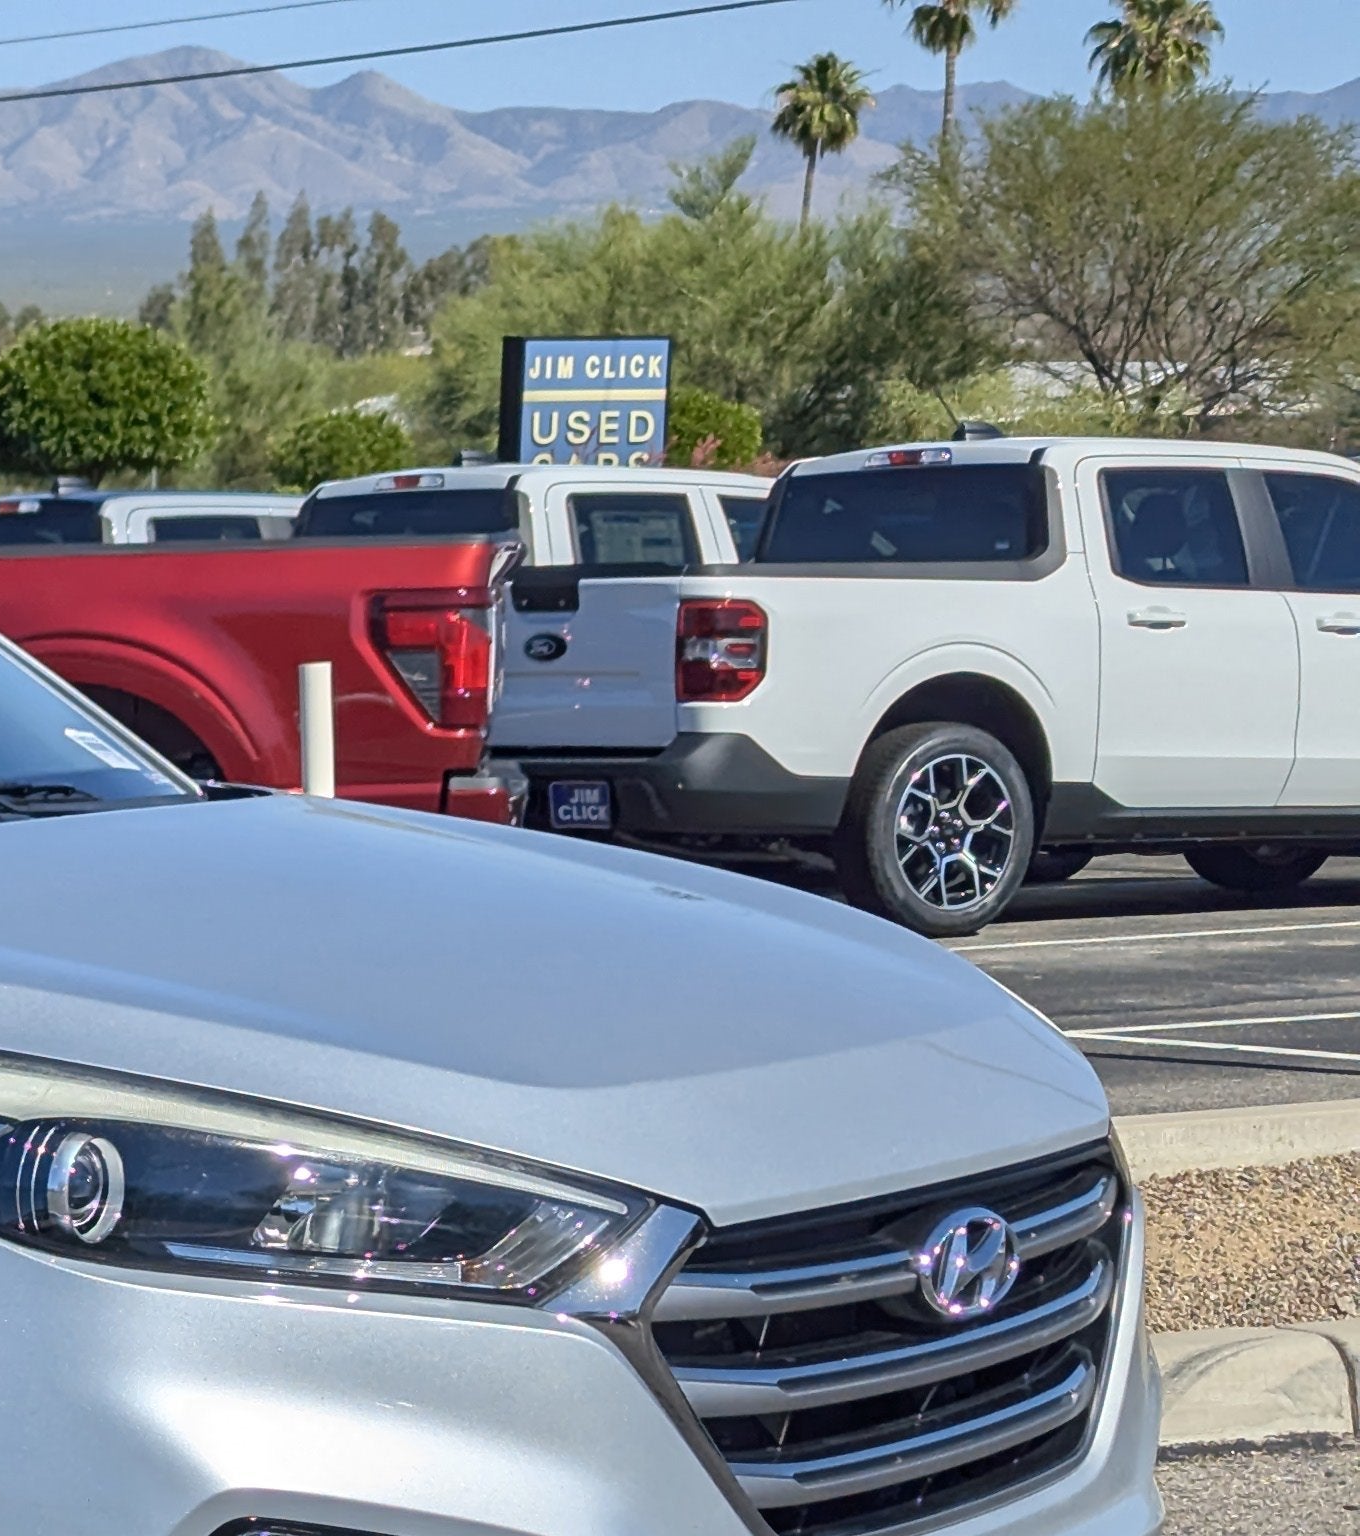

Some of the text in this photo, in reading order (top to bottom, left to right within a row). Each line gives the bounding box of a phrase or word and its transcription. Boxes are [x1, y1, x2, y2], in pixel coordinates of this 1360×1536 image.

[529, 354, 662, 379] JIM CLICK
[532, 410, 655, 445] USED
[570, 788, 600, 804] JIM
[558, 804, 609, 821] CLICK
